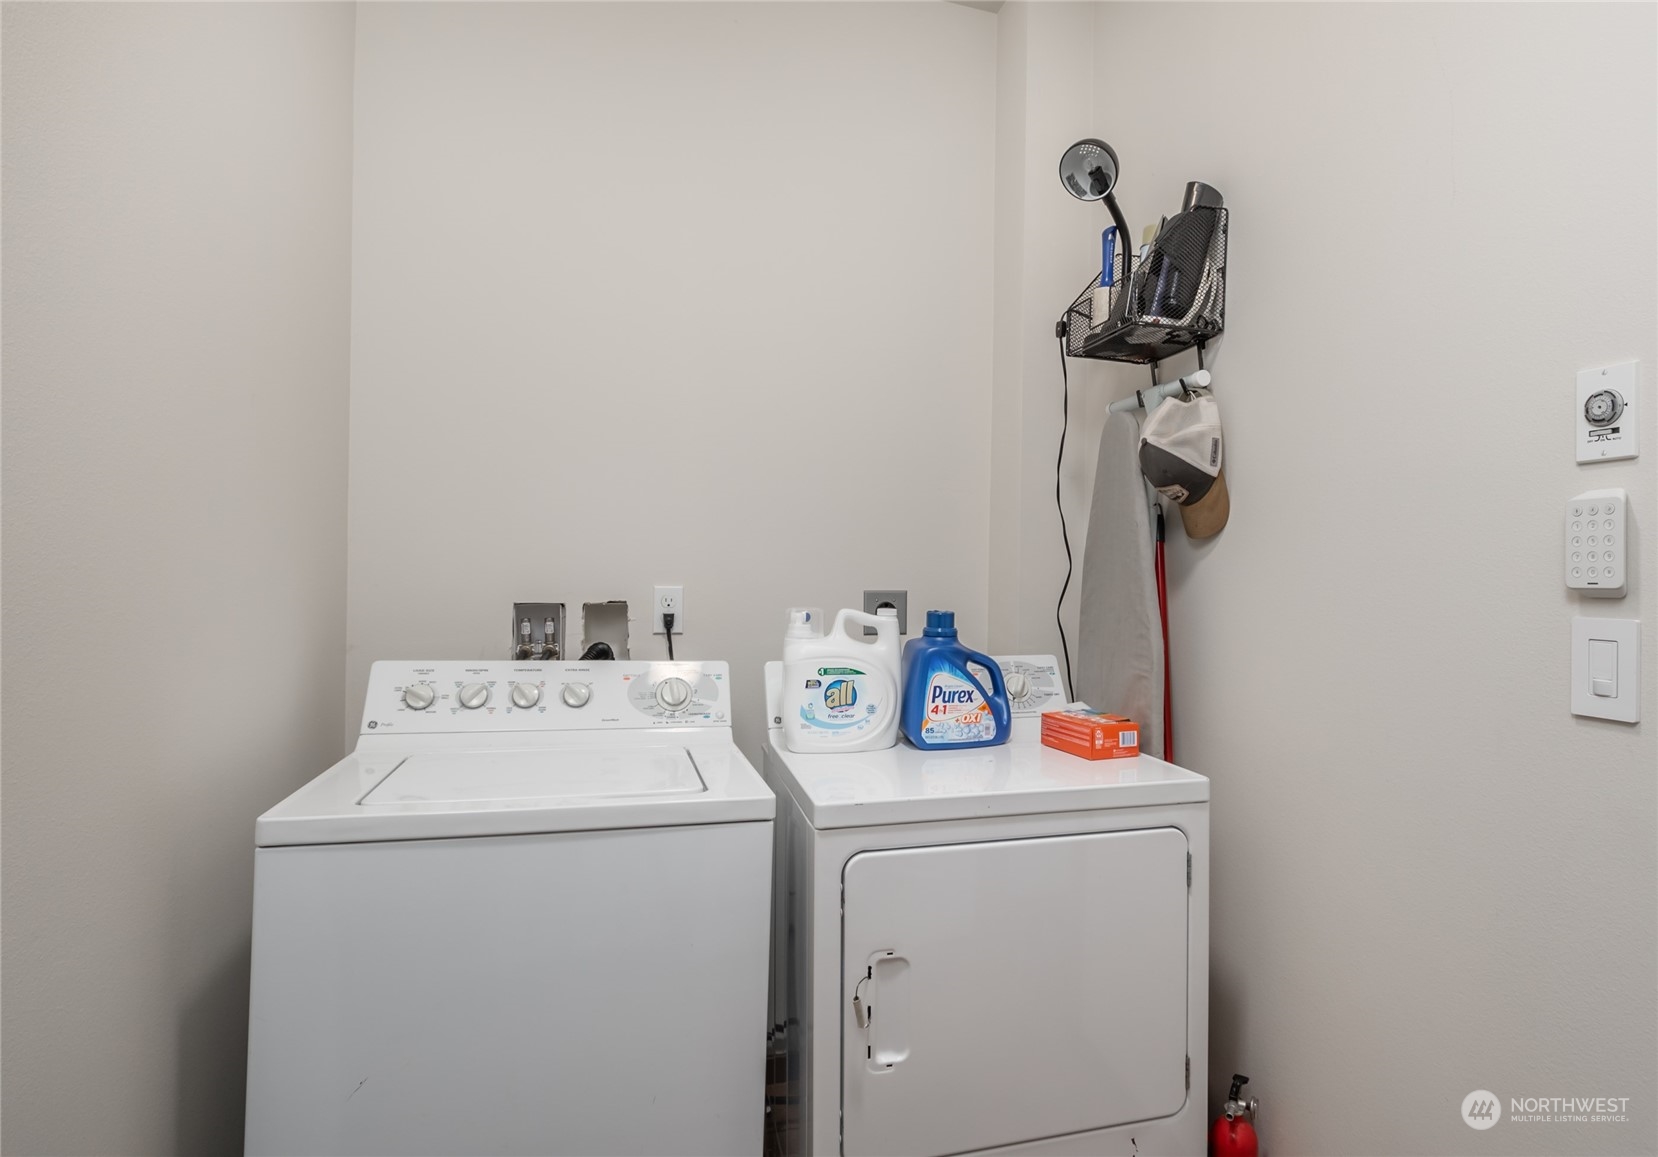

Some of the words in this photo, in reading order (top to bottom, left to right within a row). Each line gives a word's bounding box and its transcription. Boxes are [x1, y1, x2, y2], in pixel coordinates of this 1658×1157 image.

[826, 680, 854, 709] all
[931, 685, 975, 704] Purex
[961, 712, 982, 724] OXI
